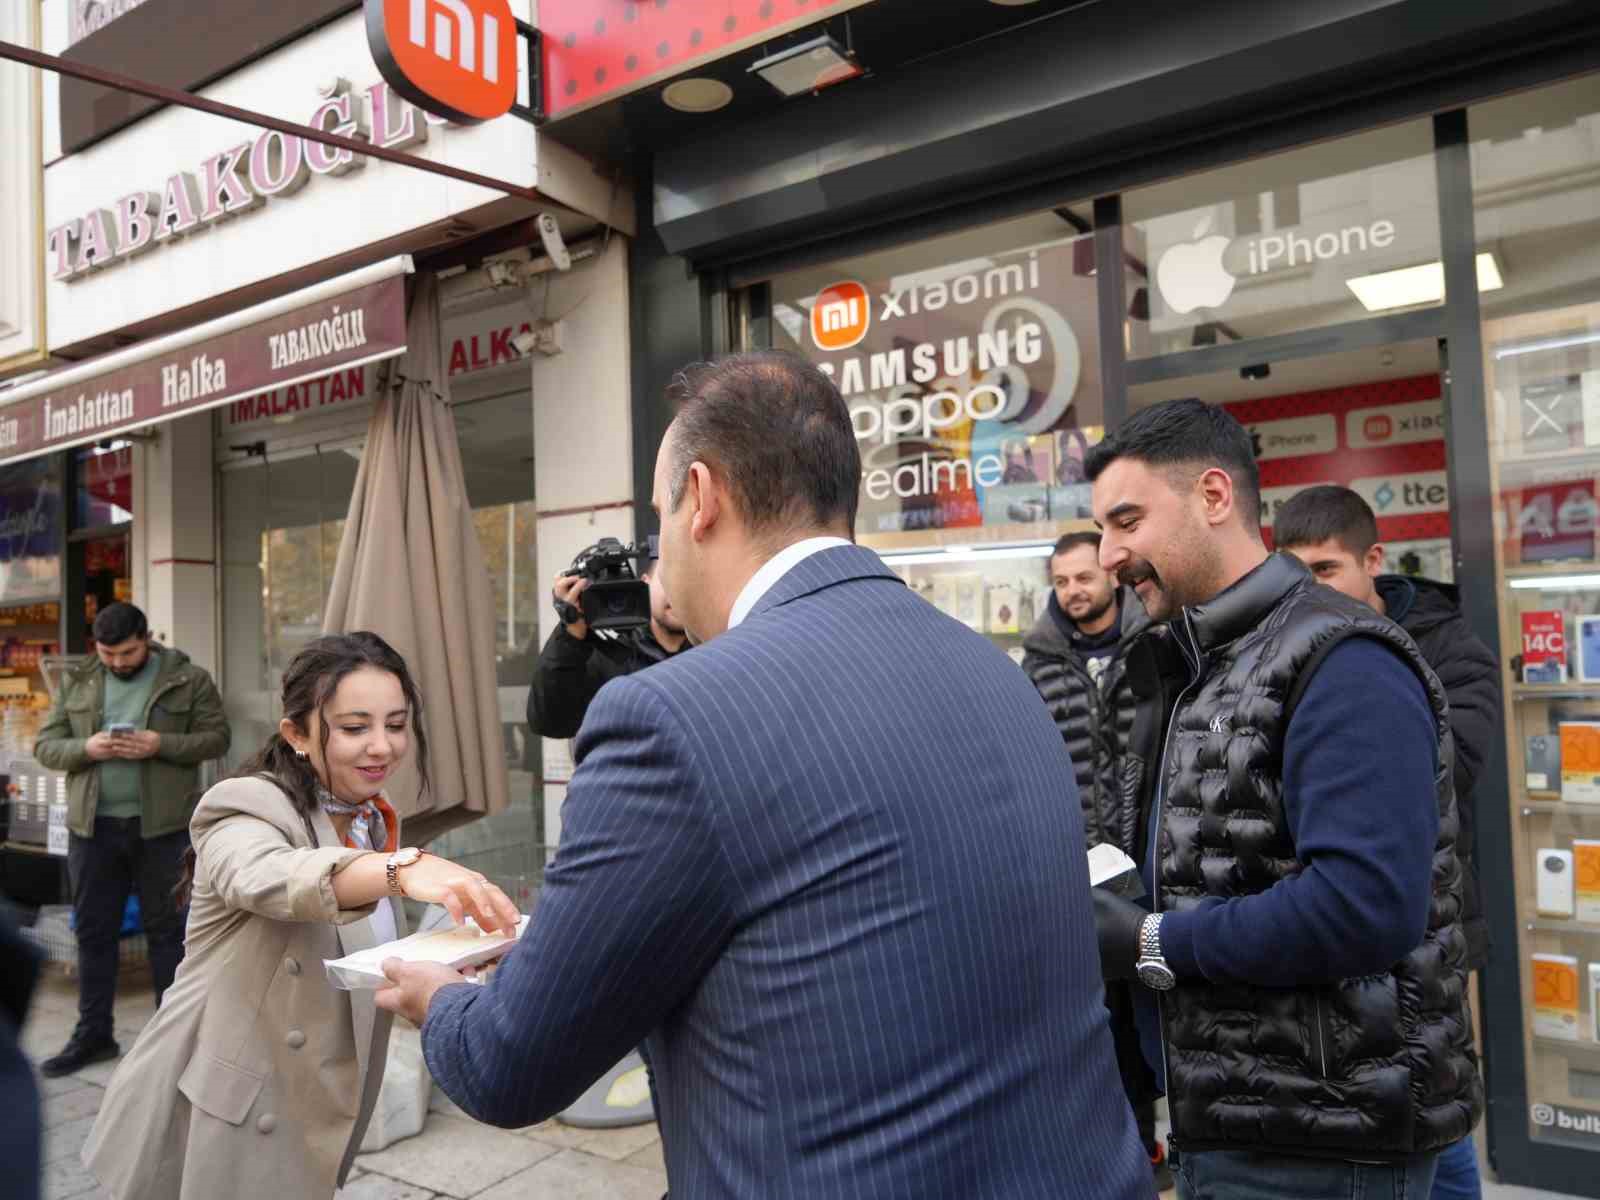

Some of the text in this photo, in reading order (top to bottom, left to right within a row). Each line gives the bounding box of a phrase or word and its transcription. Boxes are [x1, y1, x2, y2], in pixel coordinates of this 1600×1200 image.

[48, 78, 449, 281] TABAKOĞL
[1249, 219, 1396, 274] iPhone
[880, 251, 1040, 321] xiaomi
[161, 353, 227, 407] Halka
[269, 305, 367, 370] TABAKOĞLU
[849, 384, 1006, 446] oppo
[1523, 632, 1562, 653] 14C
